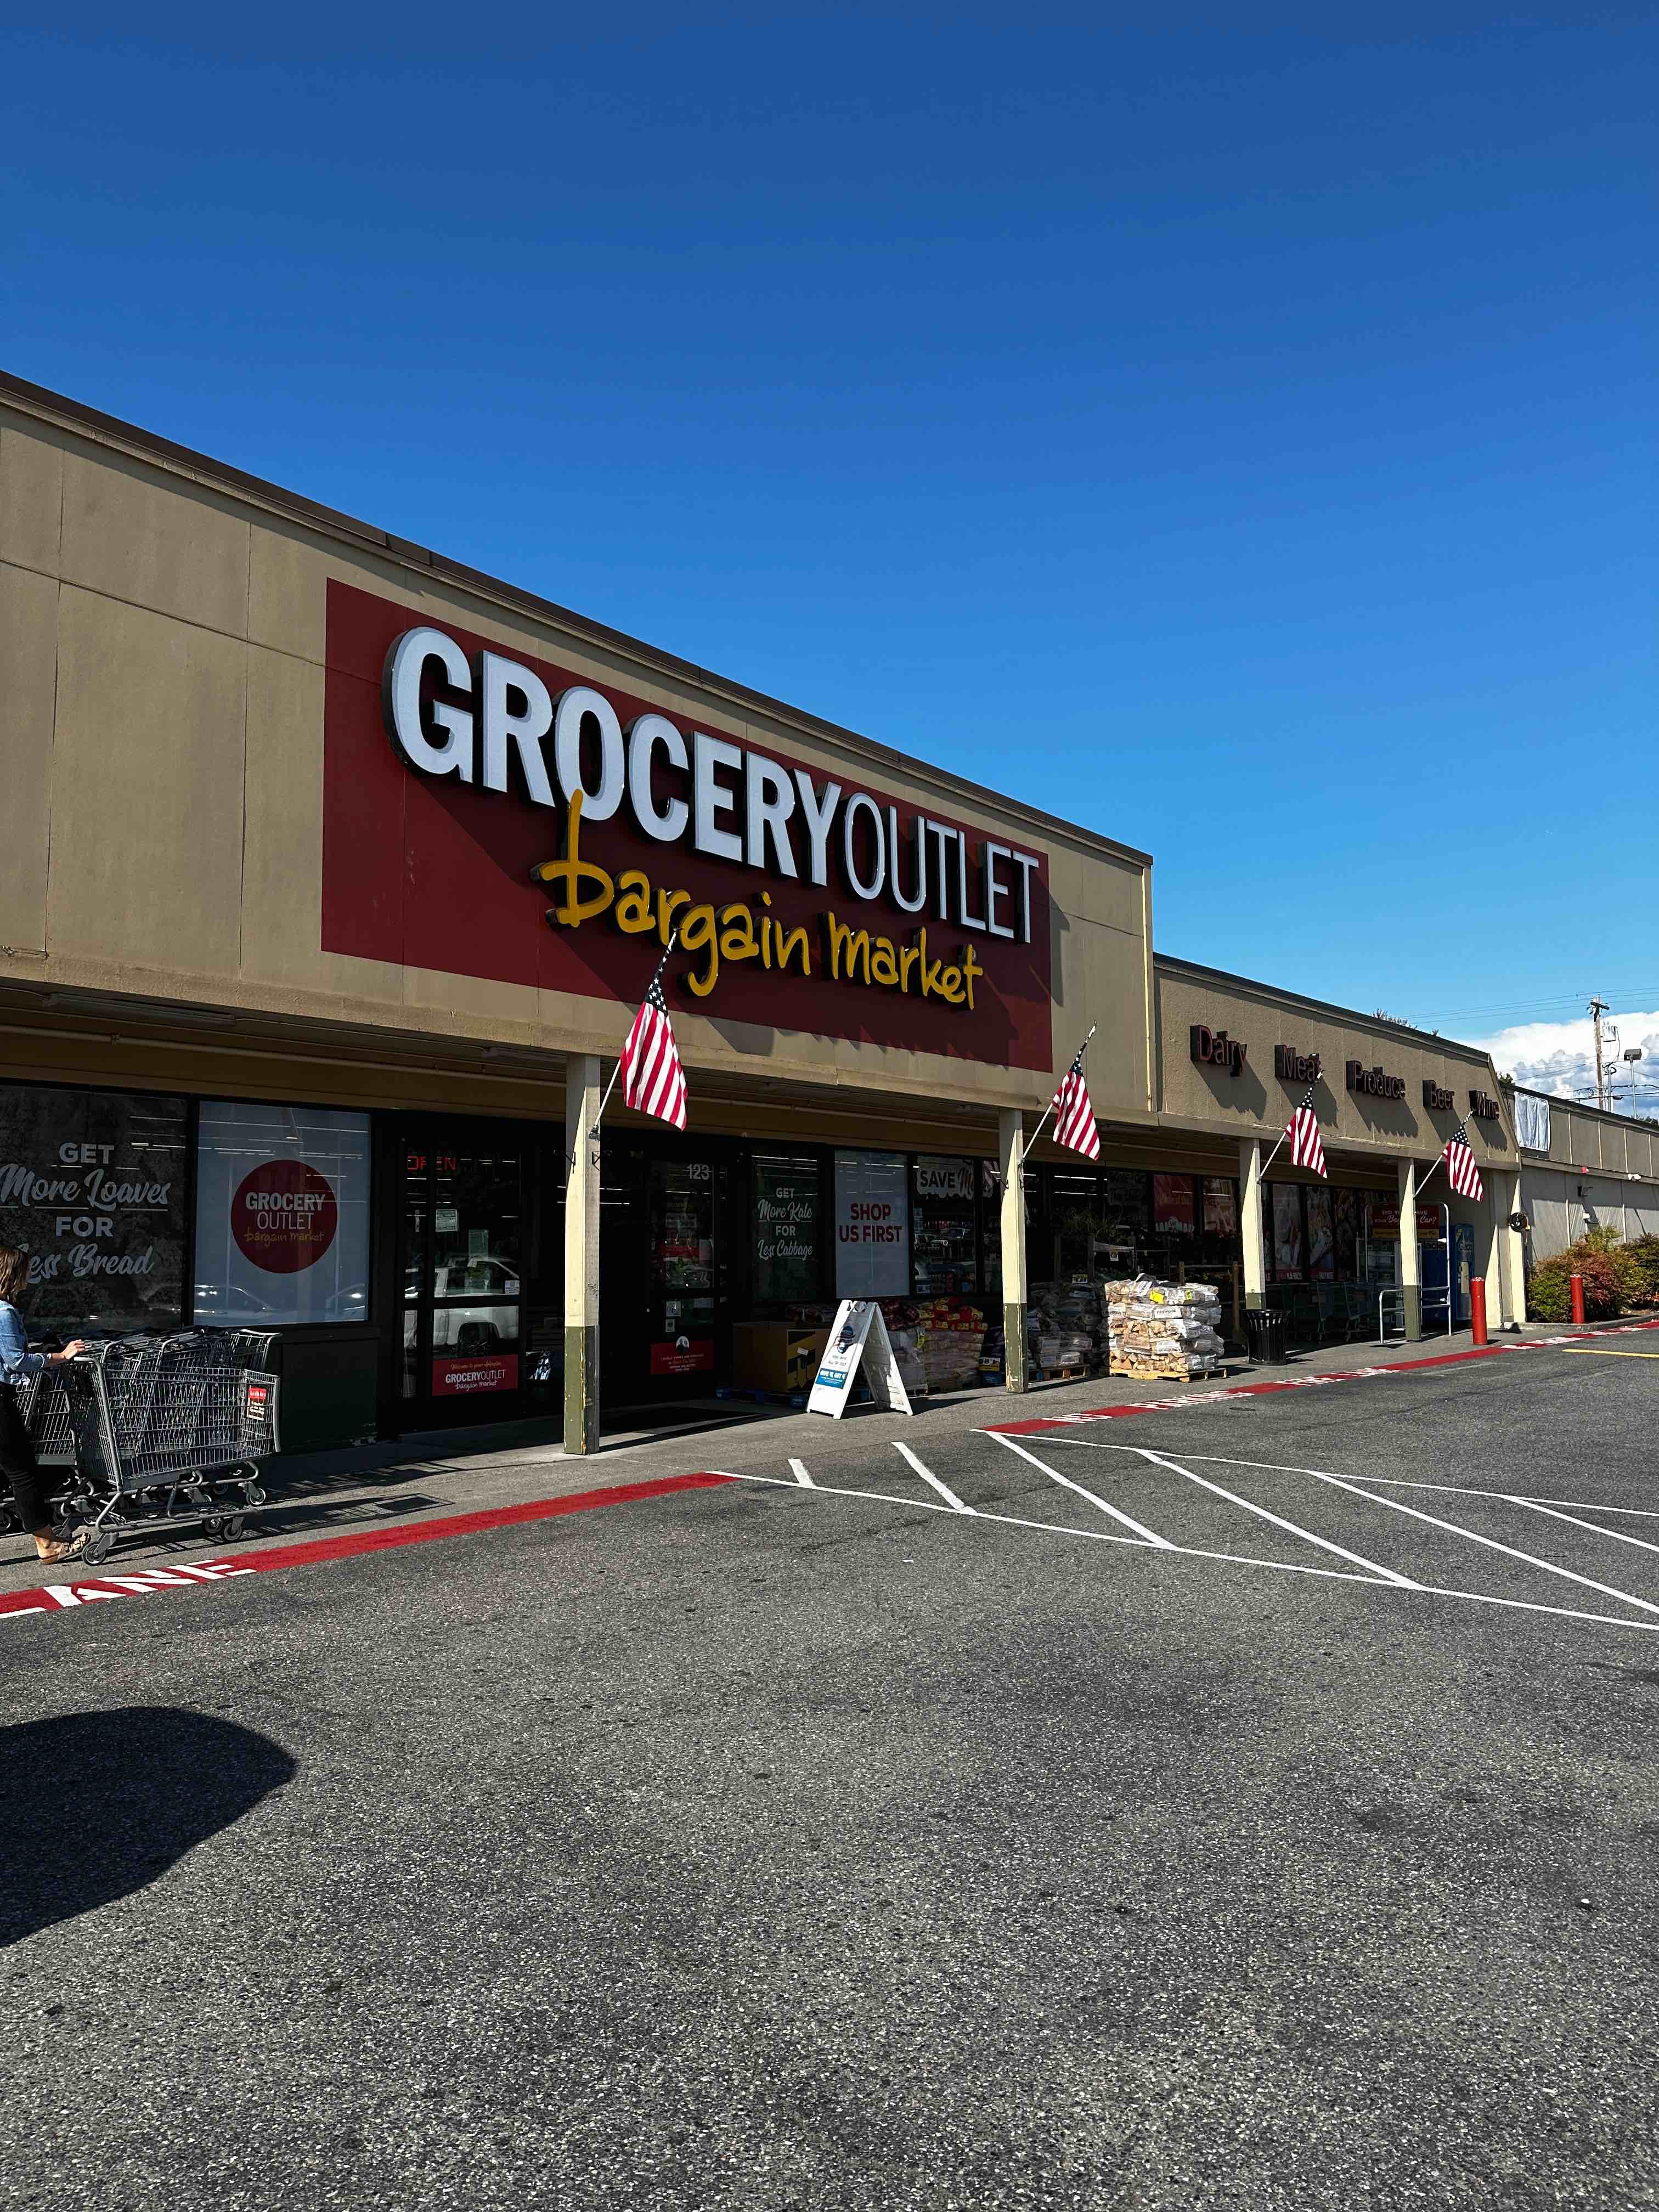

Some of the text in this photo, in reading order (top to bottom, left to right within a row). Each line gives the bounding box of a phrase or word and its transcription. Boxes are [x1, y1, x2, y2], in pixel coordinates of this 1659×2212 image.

[827, 911, 984, 1010] market
[1195, 1025, 1247, 1076] Dairy
[1350, 1060, 1406, 1099] Produce
[1426, 1080, 1455, 1110] Beer
[59, 1142, 115, 1164] GET
[689, 1164, 710, 1180] 123
[920, 1170, 955, 1189] SAVE
[0, 1164, 171, 1211] More Loaves
[776, 1187, 795, 1198] GET
[245, 1192, 325, 1211] GROCERY
[758, 1199, 812, 1222] More Kale
[850, 1203, 891, 1221] SHOP
[56, 1216, 114, 1238] FOR
[257, 1211, 314, 1229] OUTLET
[775, 1225, 795, 1237] FOR
[244, 1226, 325, 1247] bargain market
[839, 1225, 904, 1242] US FIRST
[68, 1243, 154, 1278] Bread
[758, 1239, 812, 1261] Less Cabbage
